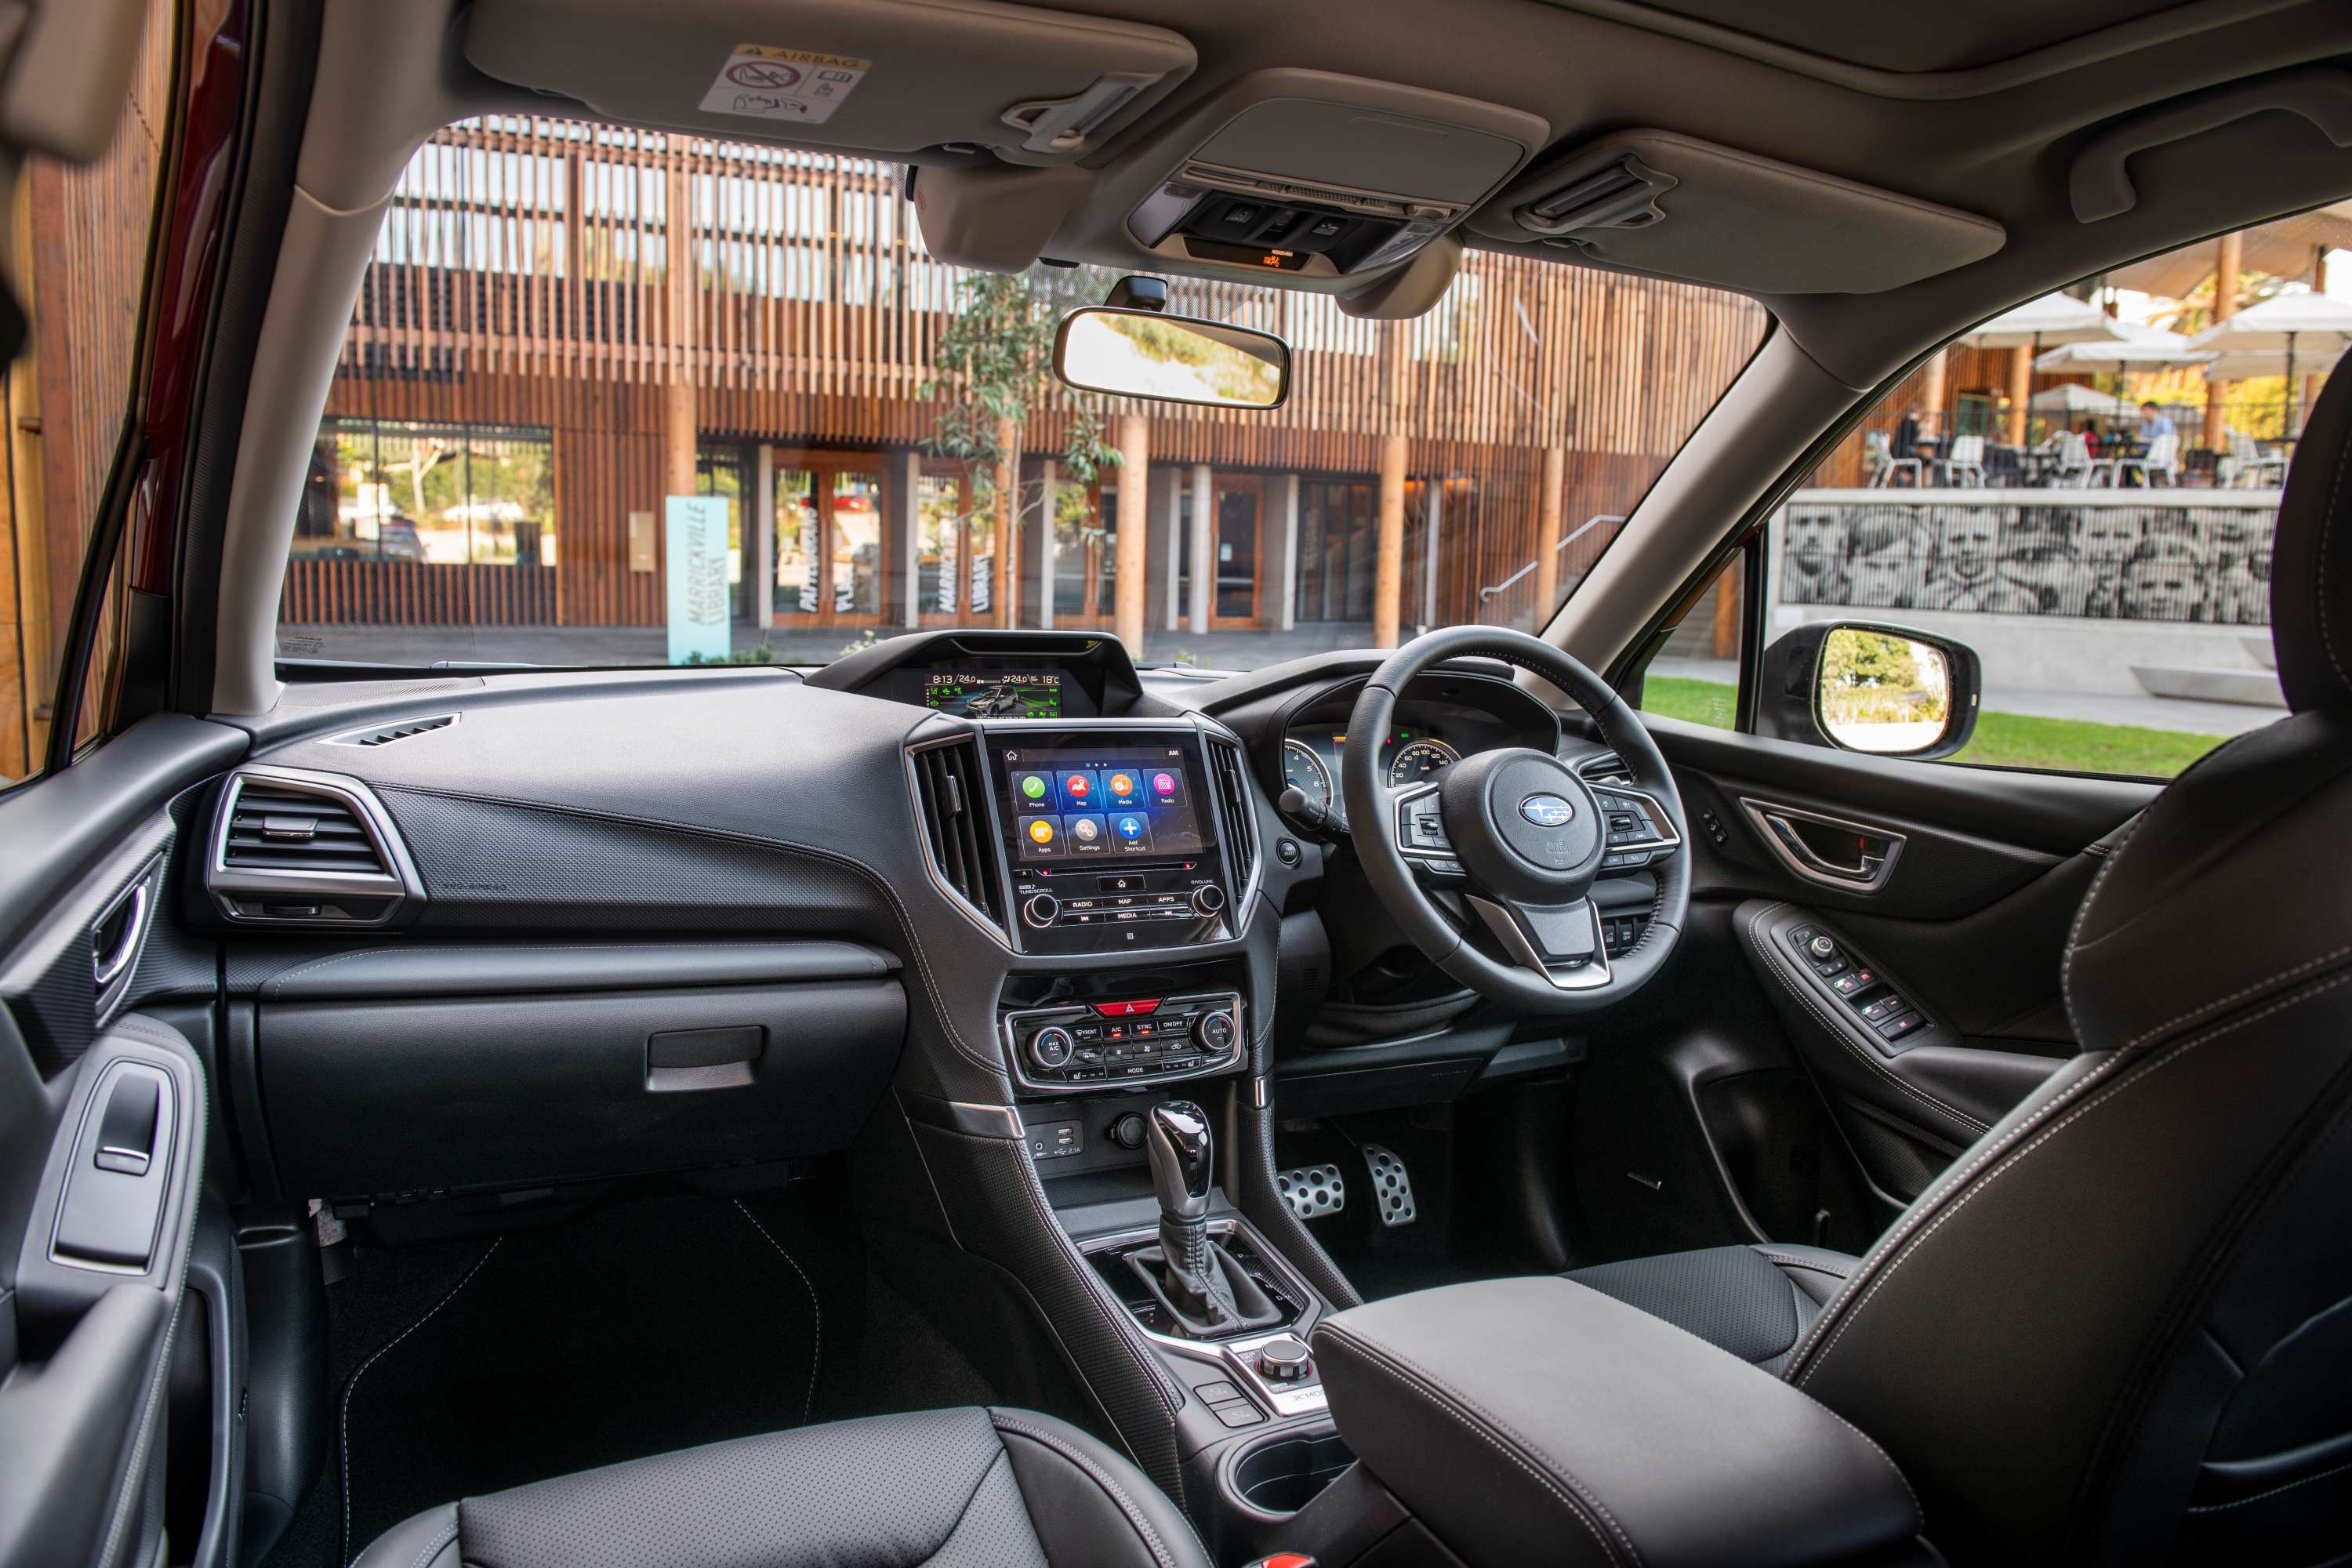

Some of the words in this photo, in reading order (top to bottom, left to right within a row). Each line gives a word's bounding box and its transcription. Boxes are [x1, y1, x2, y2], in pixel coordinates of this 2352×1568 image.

[772, 50, 860, 67] AIRBAG
[687, 502, 706, 626] MARRICKVILLE
[707, 556, 725, 626] LIBRARY
[933, 675, 953, 684] 8:13
